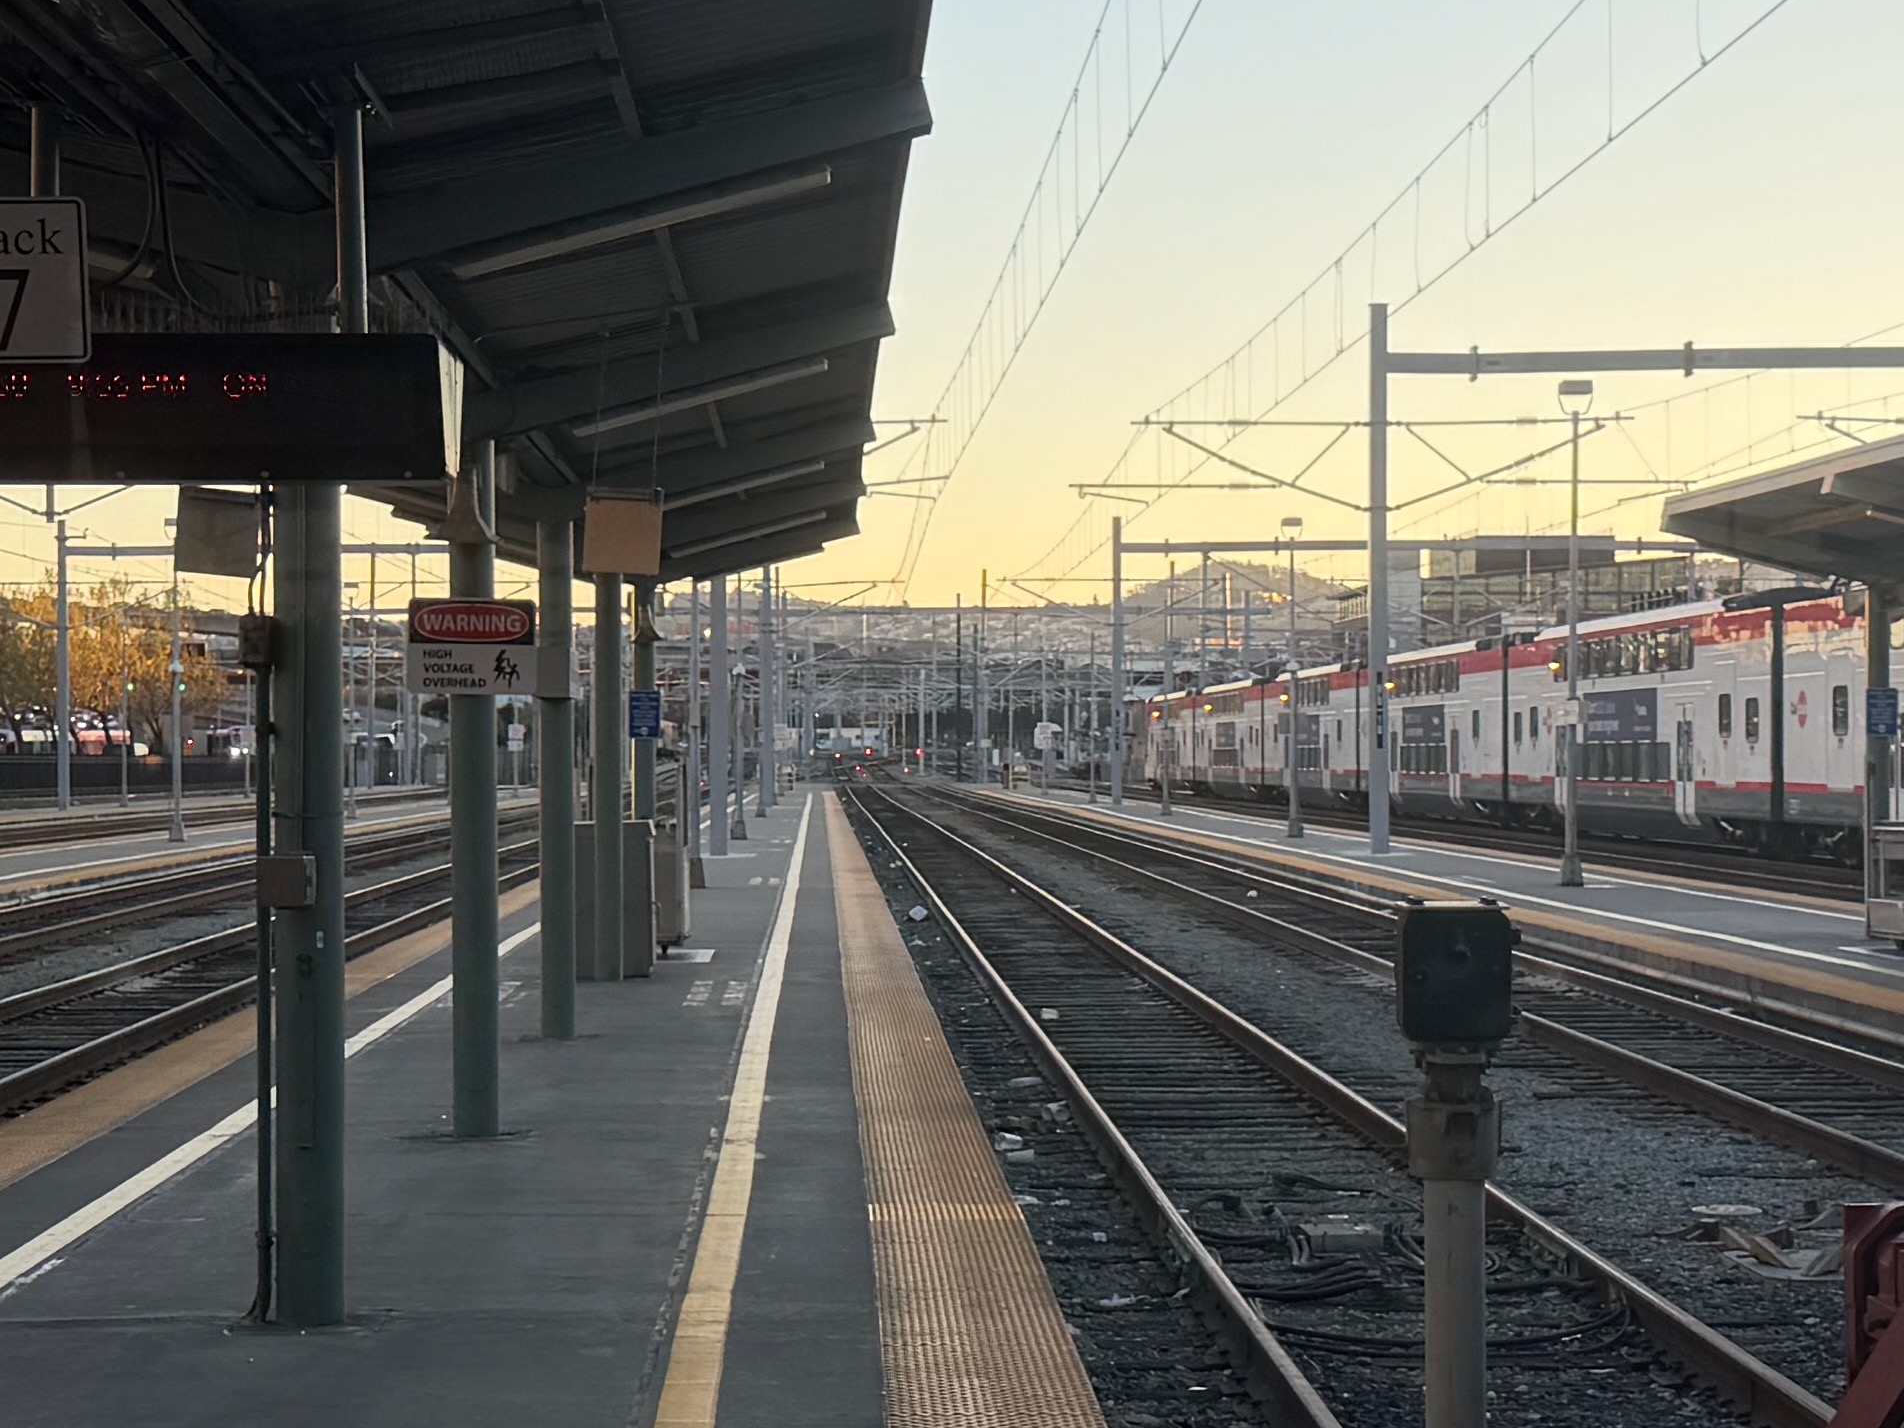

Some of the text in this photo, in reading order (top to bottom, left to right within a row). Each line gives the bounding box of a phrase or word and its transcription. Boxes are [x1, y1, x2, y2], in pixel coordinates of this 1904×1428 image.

[422, 613, 522, 633] WARNING
[422, 649, 453, 659] HIGH
[422, 663, 475, 674] VOLTAGE
[422, 677, 487, 688] OVERHEAD
